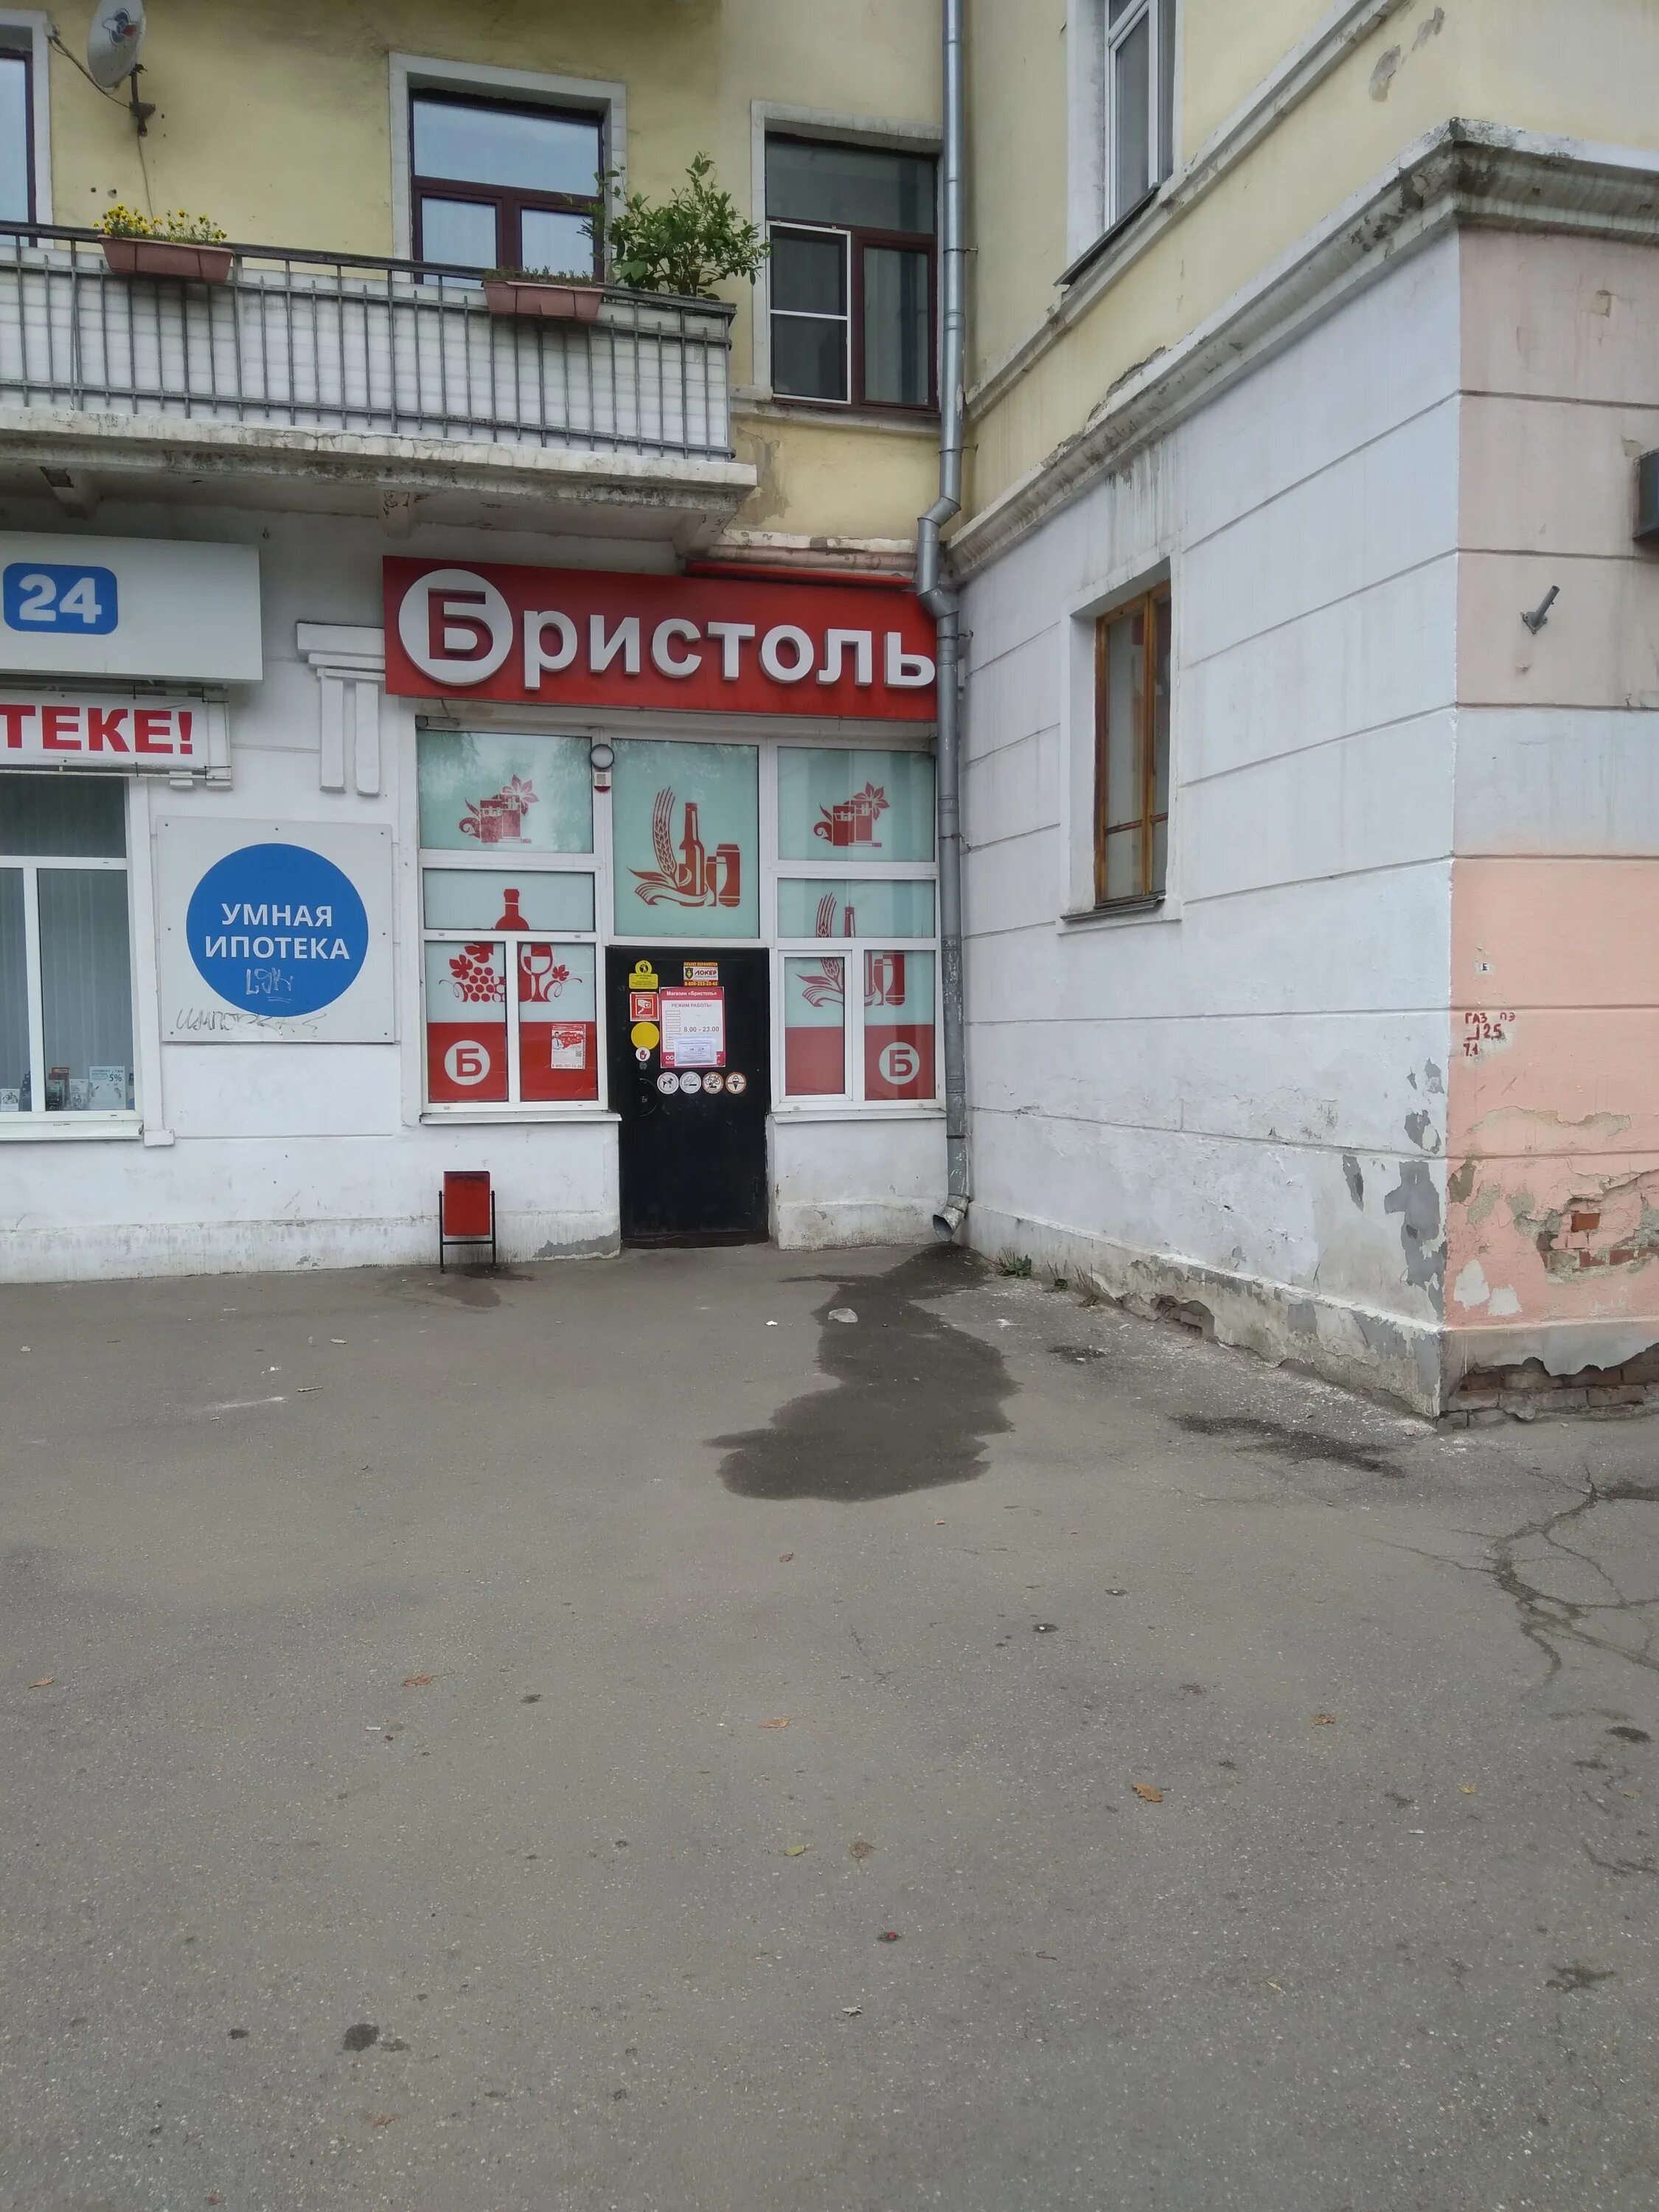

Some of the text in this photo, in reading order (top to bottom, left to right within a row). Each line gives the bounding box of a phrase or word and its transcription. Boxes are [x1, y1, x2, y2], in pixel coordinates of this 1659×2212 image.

[18, 573, 102, 625] 24
[399, 568, 936, 690] Бристоль
[221, 902, 333, 927] УМНАЯ
[205, 936, 350, 960] ИПОТЕКА
[1465, 1012, 1488, 1024] ГАЗ
[456, 1048, 483, 1077] Б
[888, 1048, 914, 1077] Б
[109, 1074, 122, 1082] 5%
